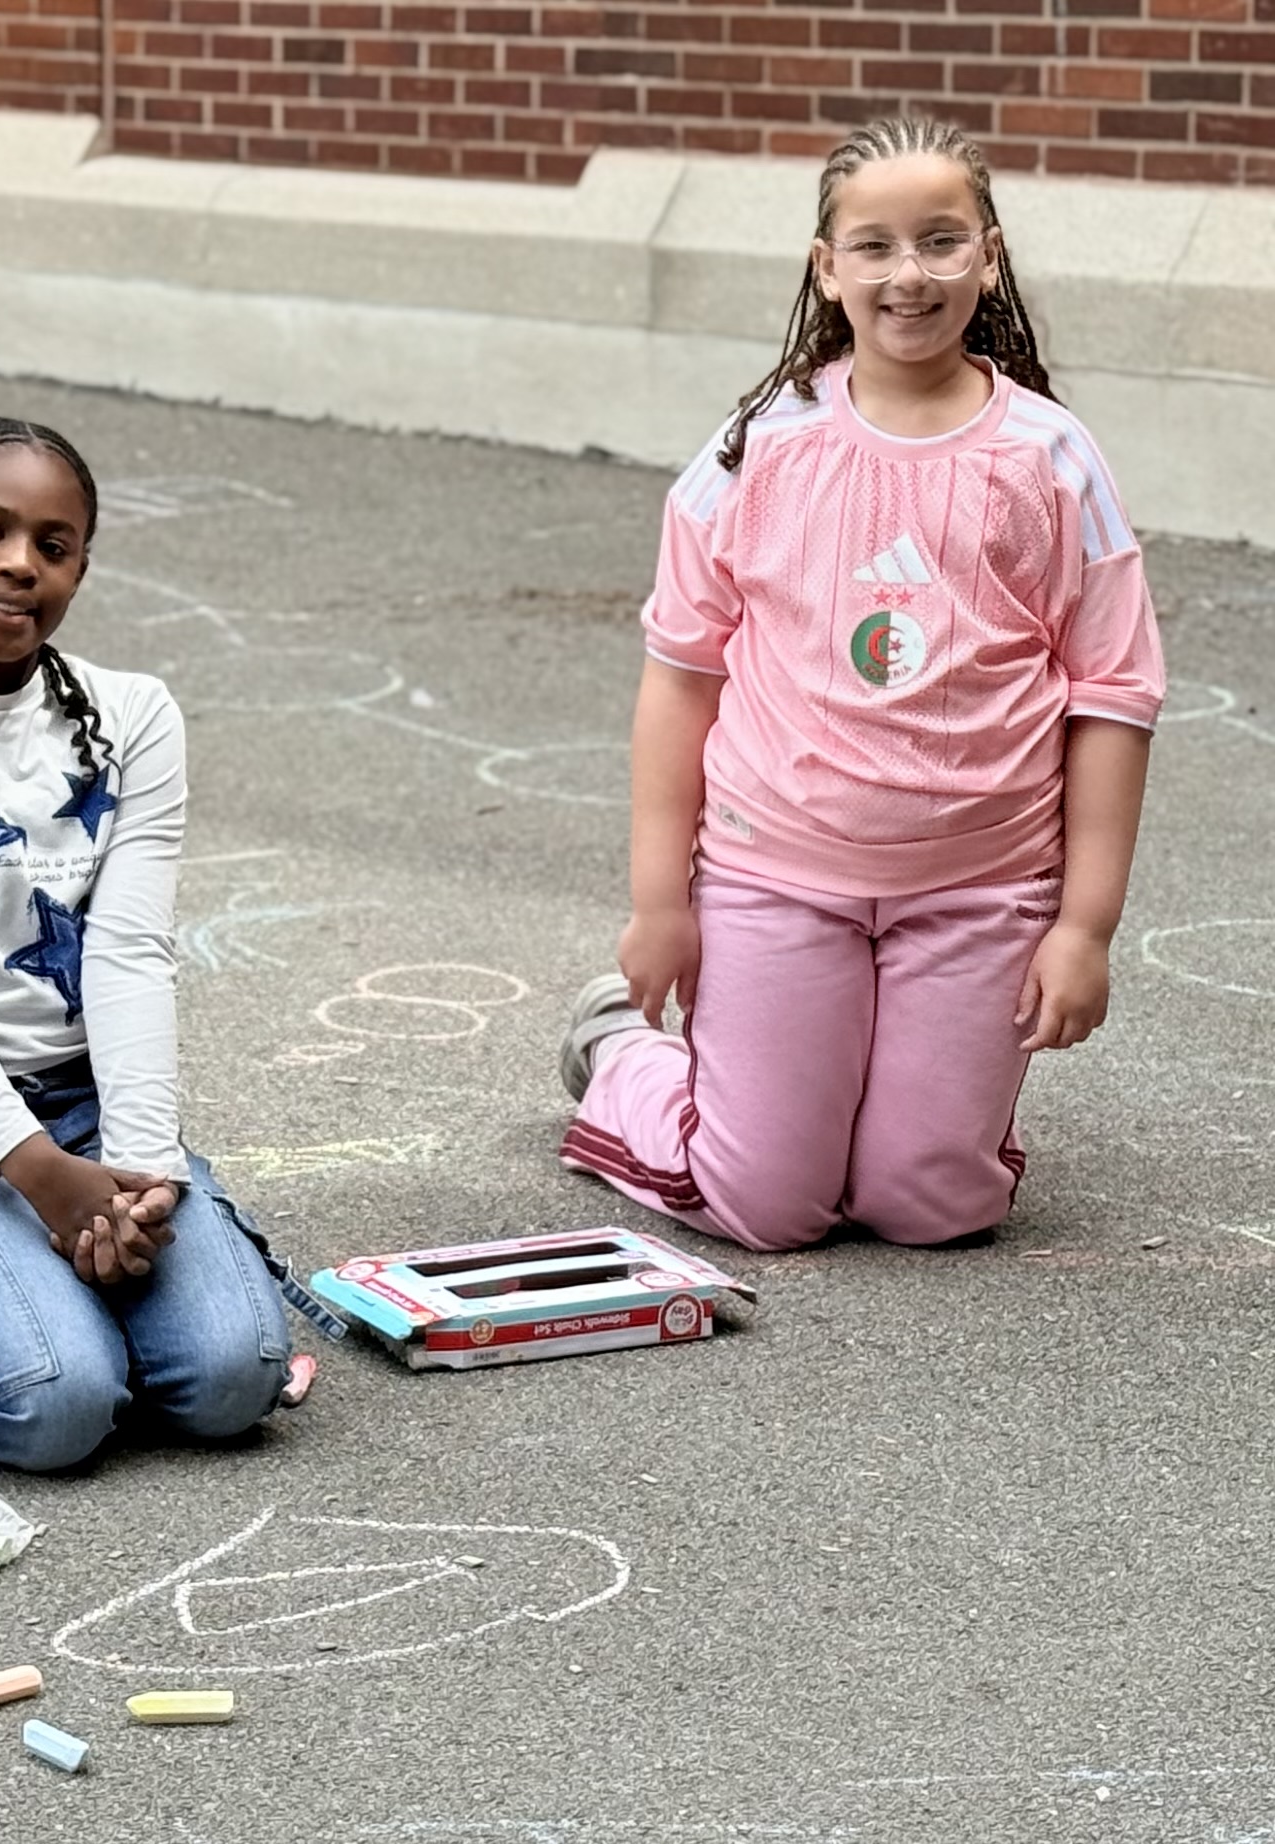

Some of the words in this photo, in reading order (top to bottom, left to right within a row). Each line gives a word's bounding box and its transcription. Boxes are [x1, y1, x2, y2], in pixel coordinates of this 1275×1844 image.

[553, 1319, 582, 1333] Chalk
[584, 1312, 630, 1329] Sidewalk
[533, 1322, 552, 1336] Set
